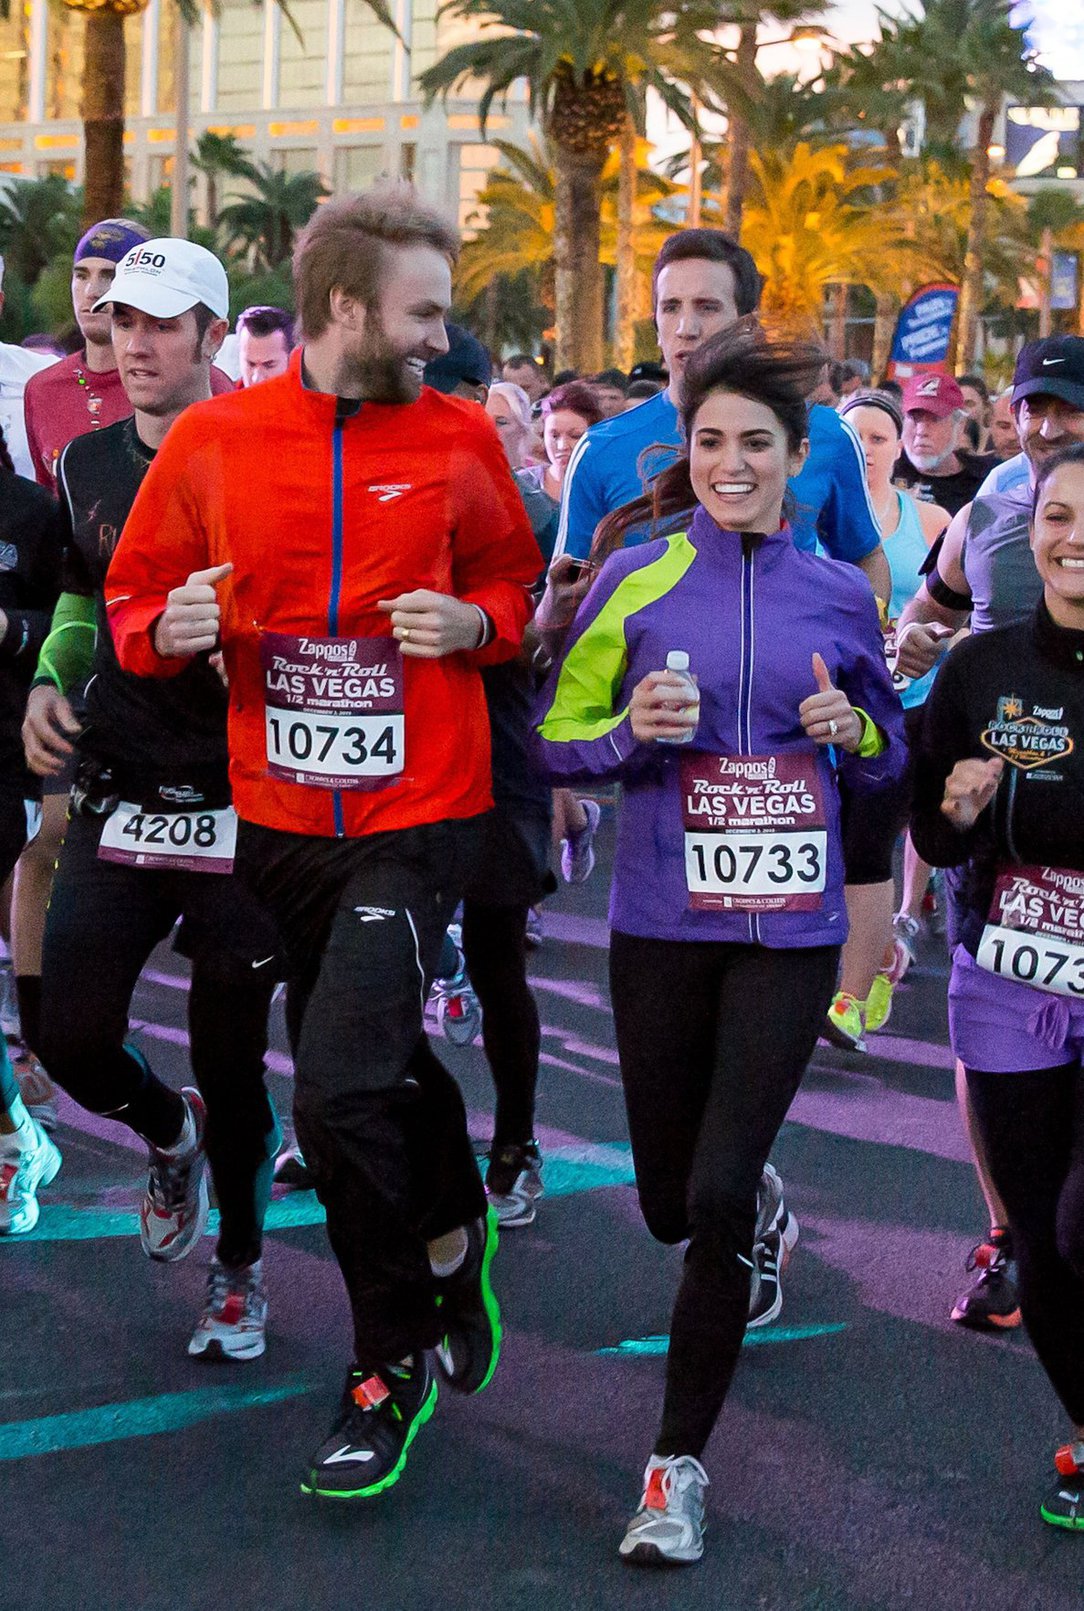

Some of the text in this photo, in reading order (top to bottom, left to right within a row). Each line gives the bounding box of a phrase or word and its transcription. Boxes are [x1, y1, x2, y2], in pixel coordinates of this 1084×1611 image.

[299, 638, 348, 660] Zappos
[272, 656, 323, 676] Rock
[341, 662, 388, 677] Roll
[266, 670, 396, 698] LAS VEGAS
[285, 694, 373, 708] 1/2 marathon
[269, 718, 397, 765] 10734
[990, 731, 1066, 752] LAS VEGAS
[719, 757, 768, 778] Zappos
[693, 780, 746, 795] Rock
[762, 779, 807, 794] Roll
[687, 794, 816, 816] LAS VEGAS
[122, 813, 217, 848] 4208
[707, 815, 796, 826] 1/2 marathon
[692, 842, 821, 884] 10733
[353, 906, 397, 917] BROOKS
[999, 890, 1044, 917] LAS
